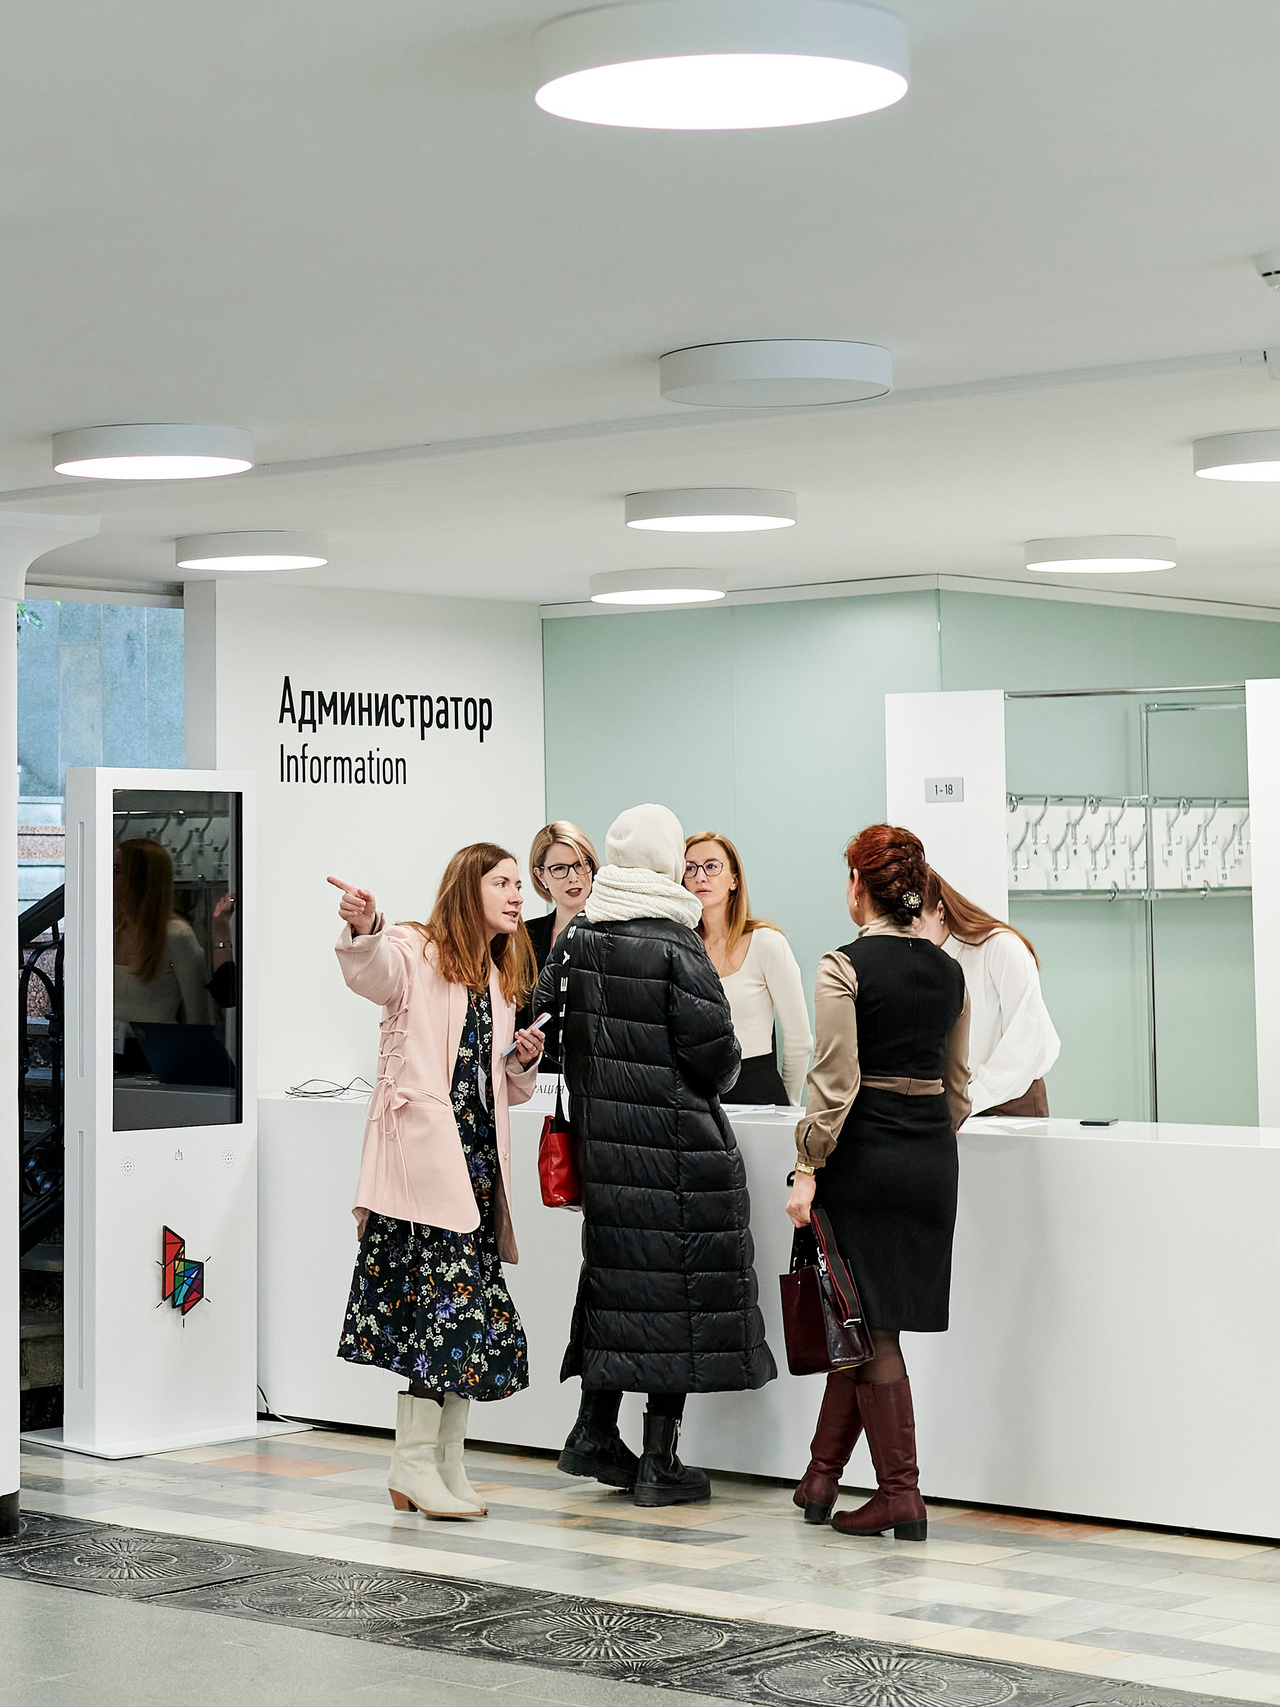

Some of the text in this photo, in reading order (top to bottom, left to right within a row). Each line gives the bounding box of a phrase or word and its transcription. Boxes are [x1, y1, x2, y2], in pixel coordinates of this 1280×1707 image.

[279, 675, 493, 743] Администратор
[280, 743, 407, 785] Information
[934, 783, 953, 796] 1-18
